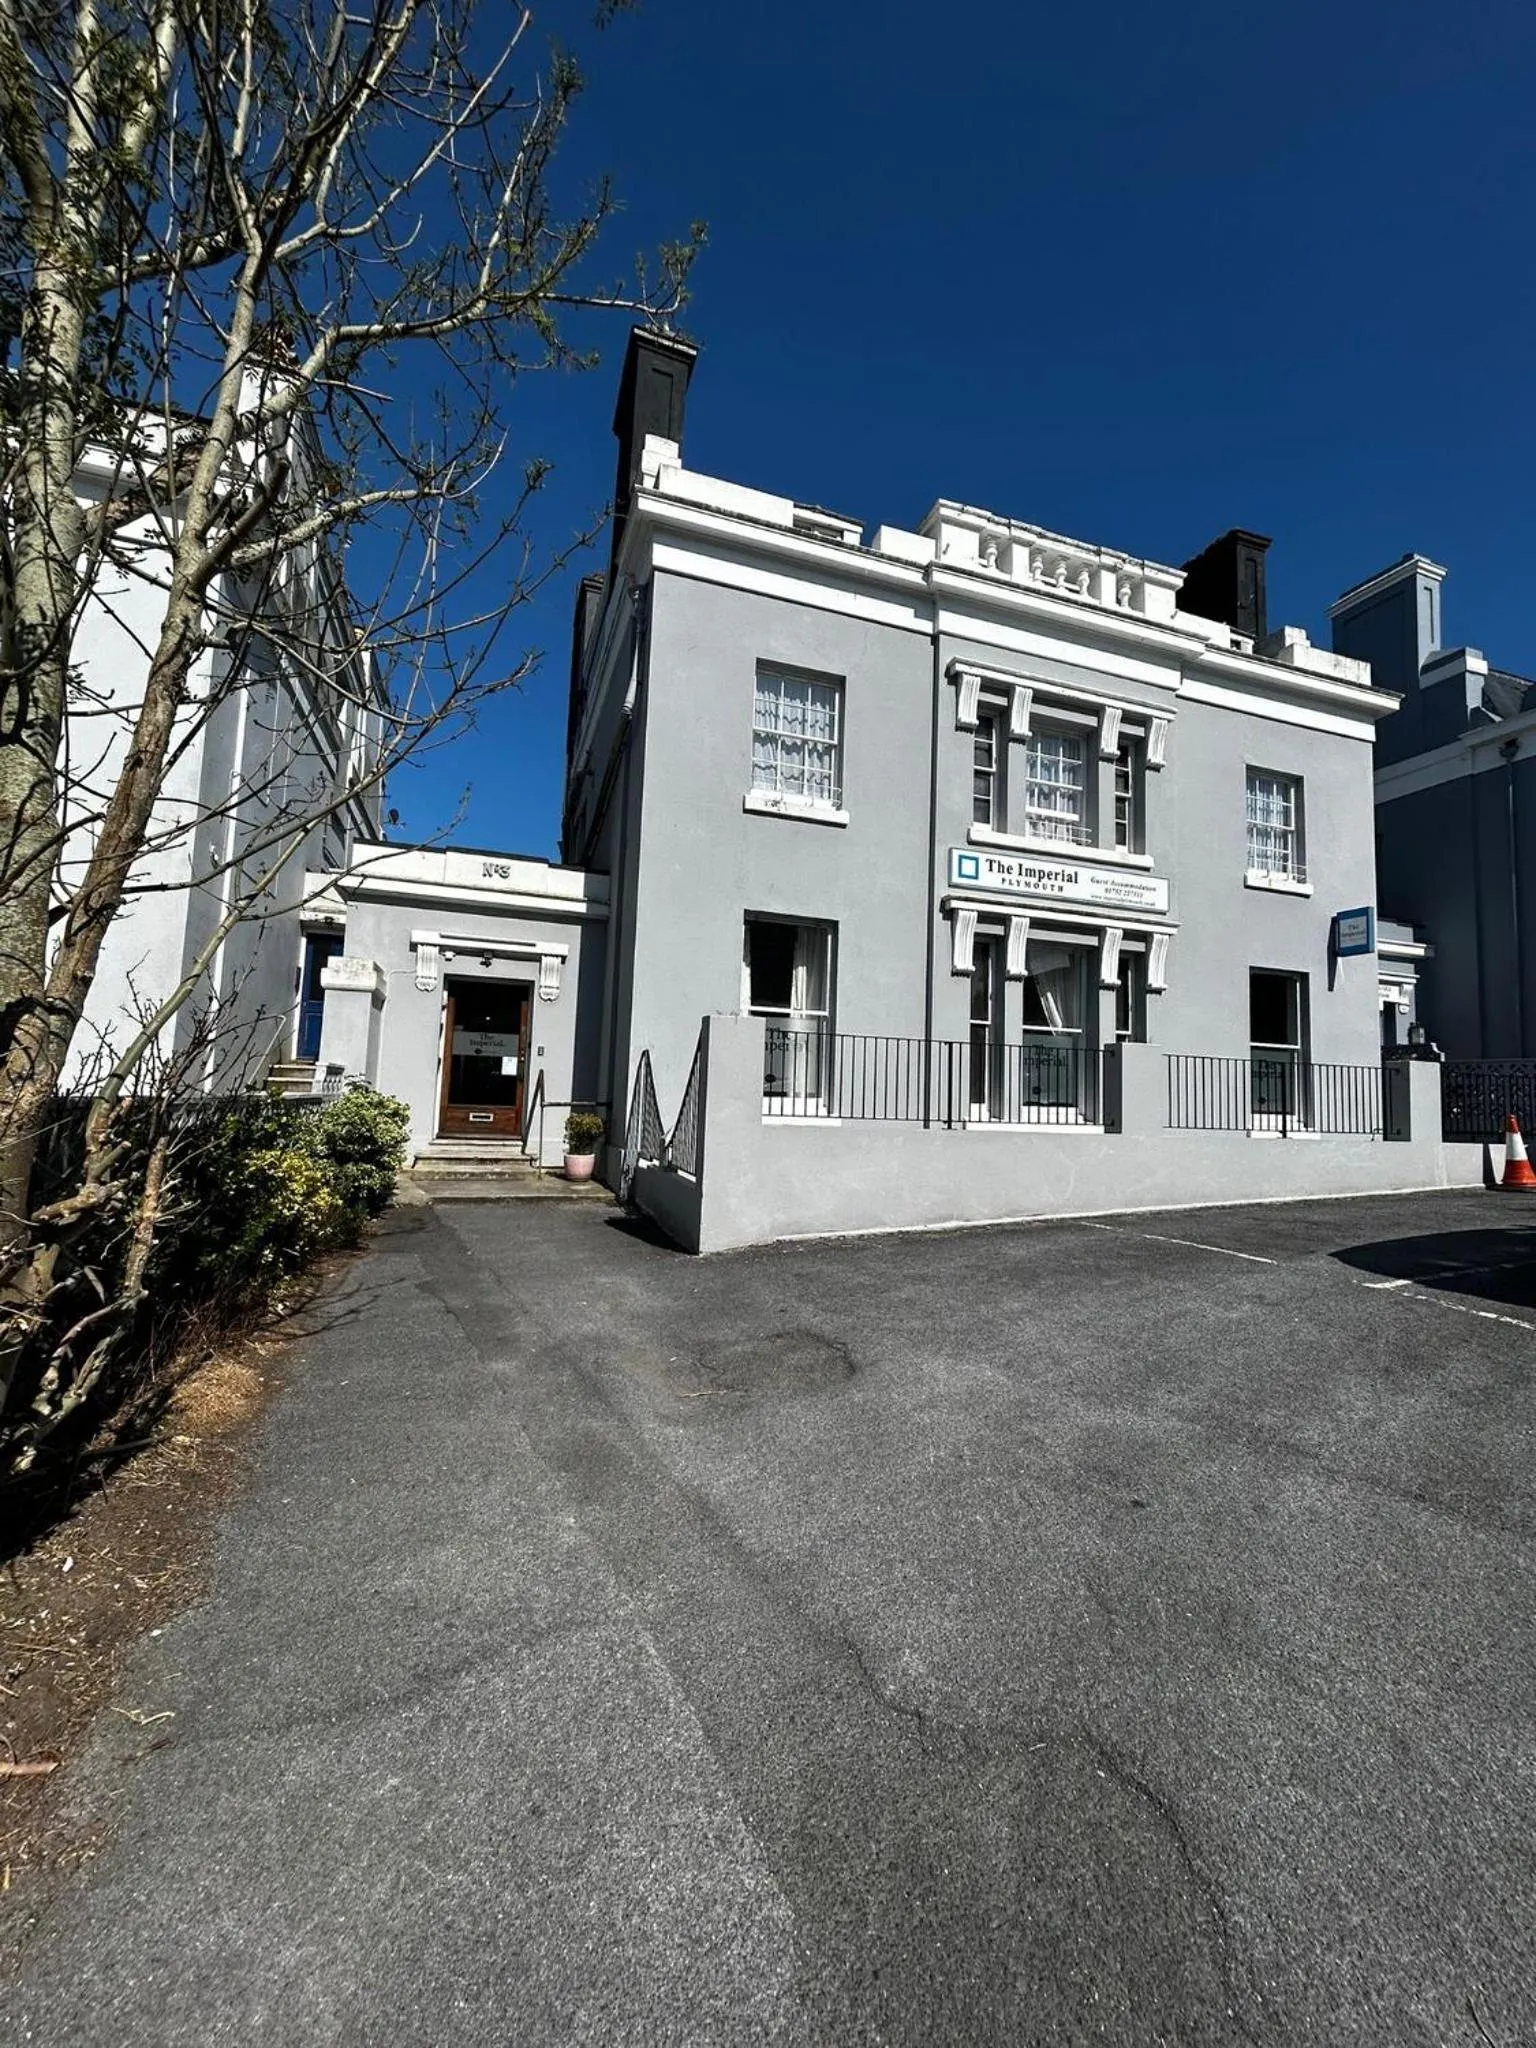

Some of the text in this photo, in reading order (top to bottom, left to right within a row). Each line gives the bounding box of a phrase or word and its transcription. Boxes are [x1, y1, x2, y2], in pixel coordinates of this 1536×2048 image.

[986, 858, 1079, 884] The Imperial
[1001, 877, 1064, 893] PLYMOUTH
[1090, 876, 1108, 885] Guest
